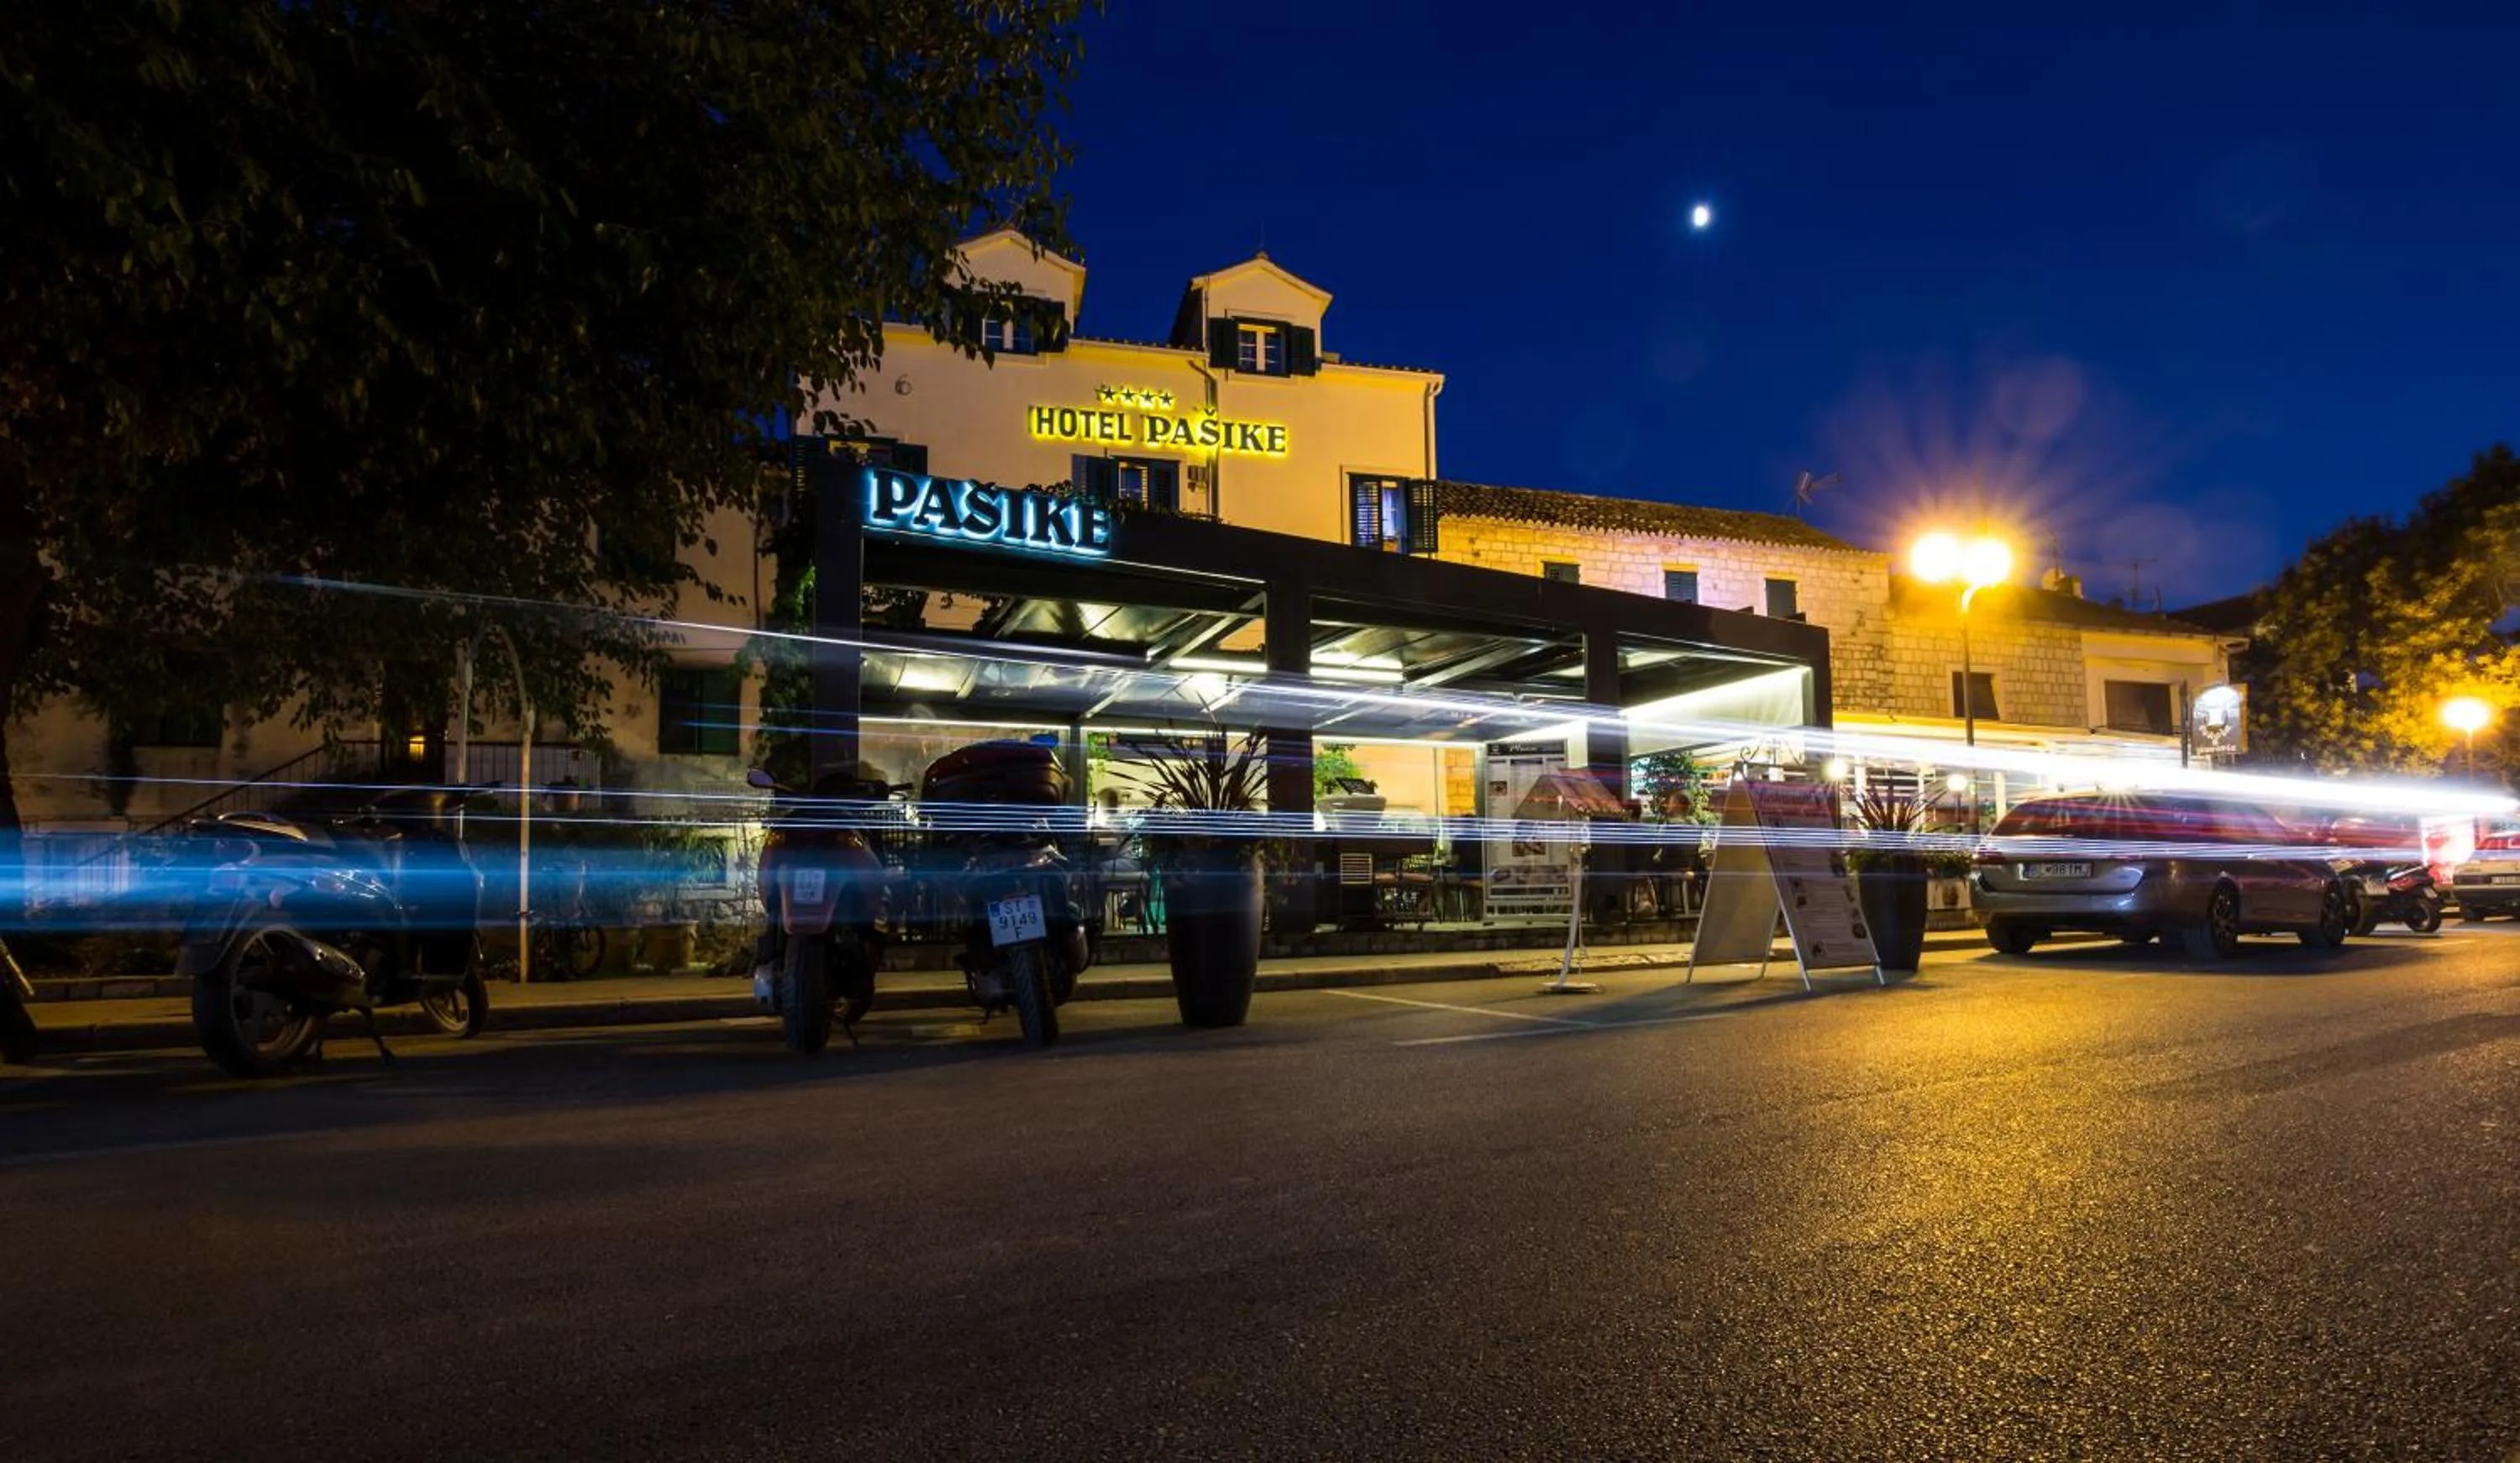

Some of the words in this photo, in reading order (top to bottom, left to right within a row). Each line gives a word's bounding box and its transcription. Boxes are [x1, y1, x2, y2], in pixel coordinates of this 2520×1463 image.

[1035, 406, 1132, 441] HOTEL
[1145, 408, 1285, 453] PAŠIKE
[871, 468, 1110, 550] PAŠIKE
[1003, 900, 1021, 914] ST
